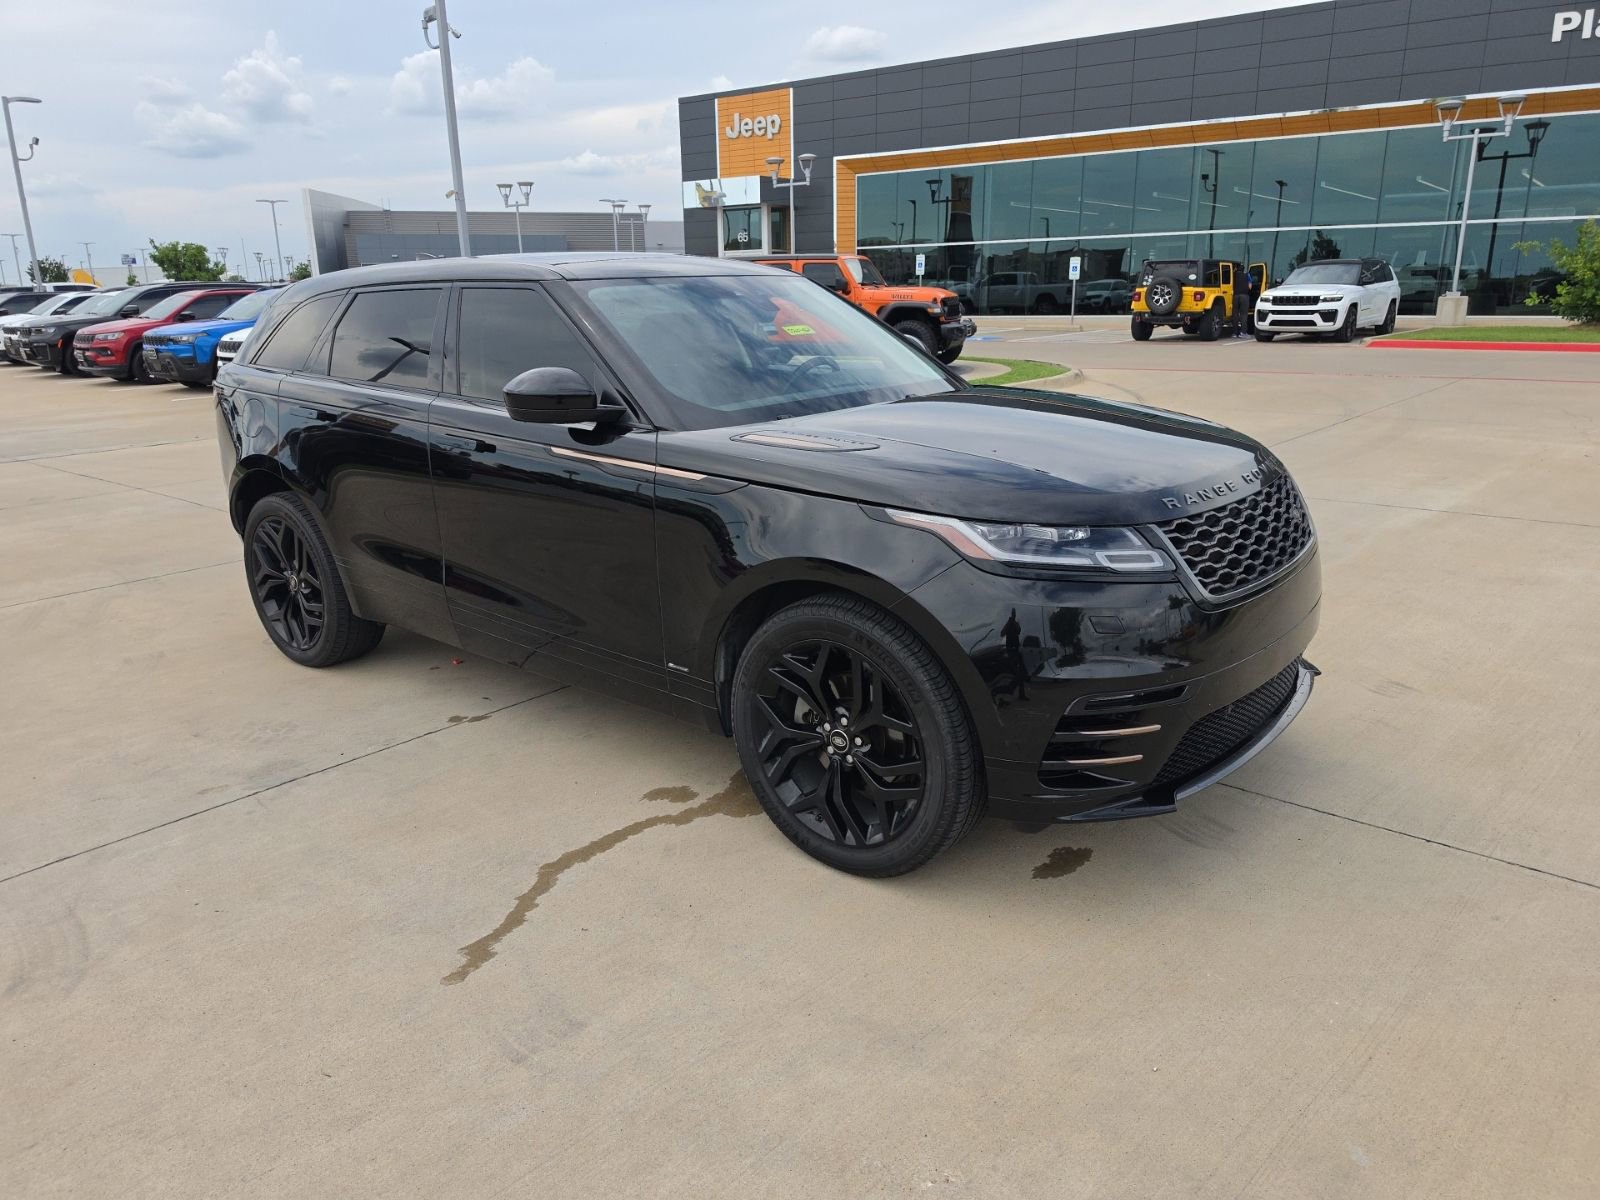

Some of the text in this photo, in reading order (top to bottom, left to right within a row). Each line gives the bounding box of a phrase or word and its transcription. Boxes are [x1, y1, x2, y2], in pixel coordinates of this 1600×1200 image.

[725, 112, 781, 140] Jeep
[737, 231, 749, 243] 65
[1162, 463, 1269, 509] RANGE ROV
